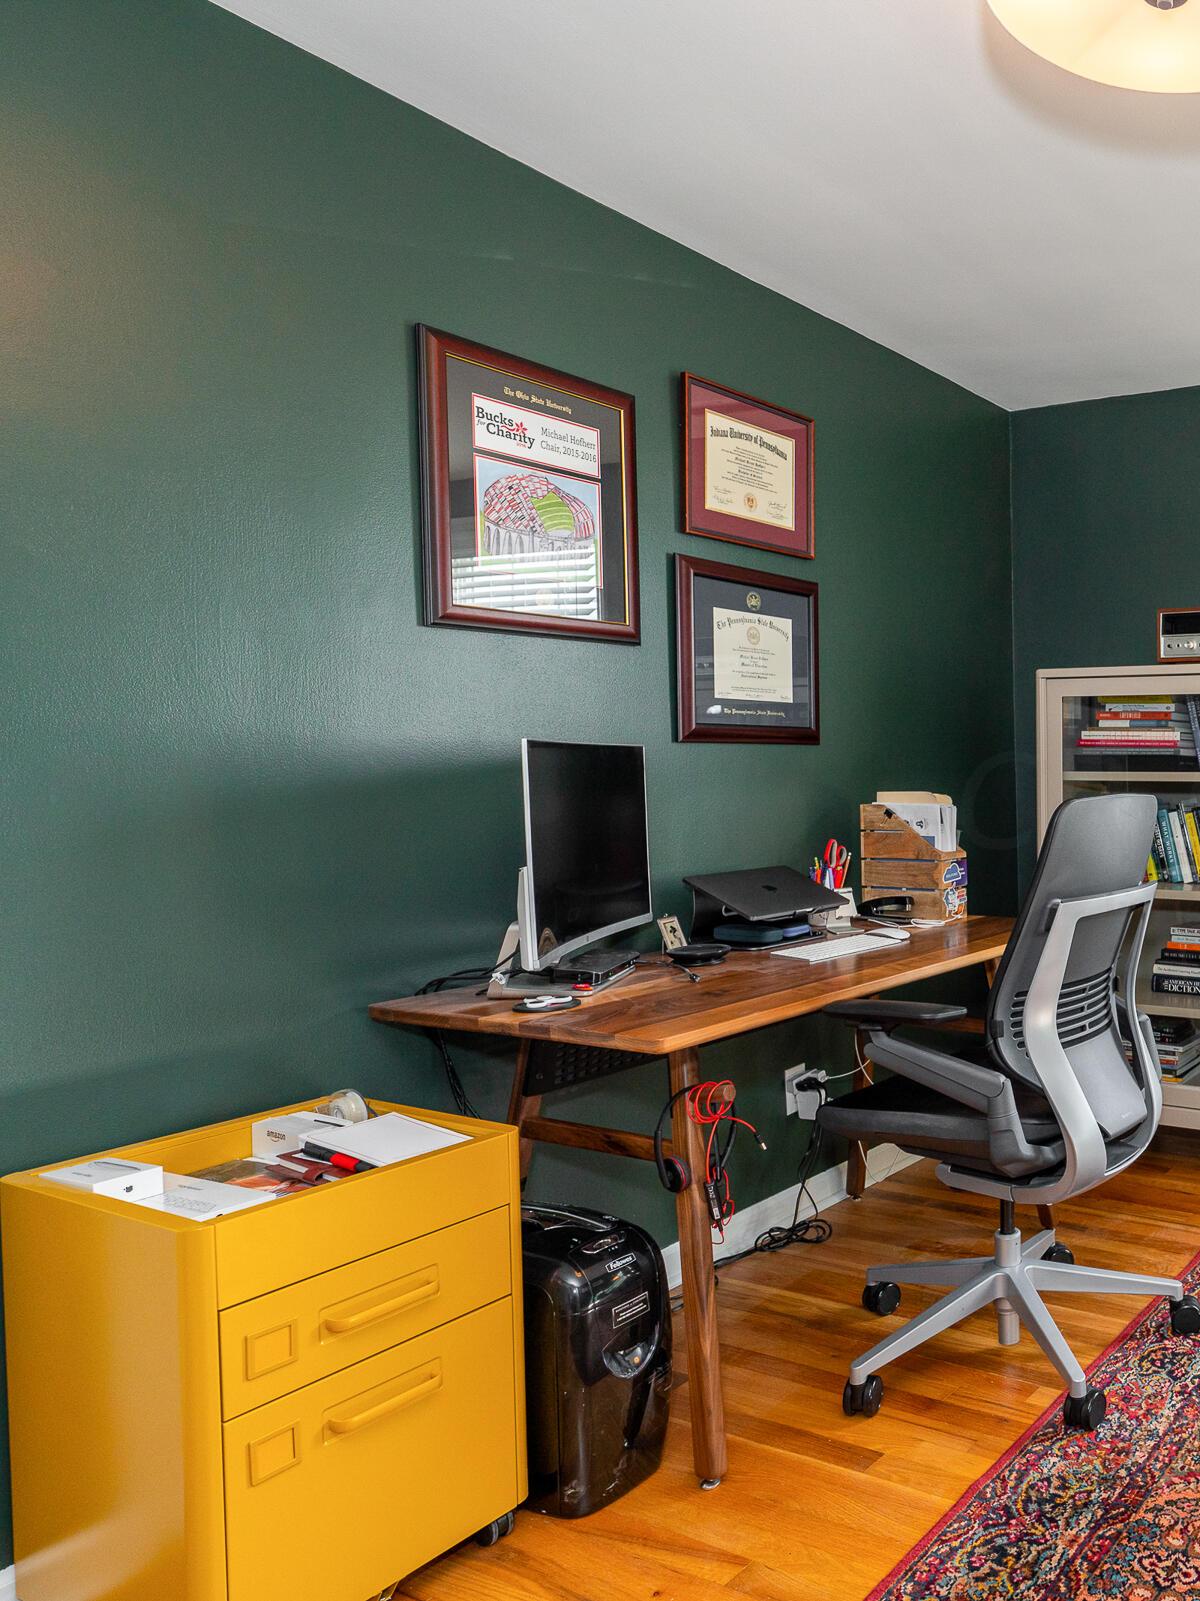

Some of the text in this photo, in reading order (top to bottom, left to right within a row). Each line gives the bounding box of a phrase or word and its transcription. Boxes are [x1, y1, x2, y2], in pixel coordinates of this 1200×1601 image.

[504, 386, 514, 397] The
[530, 394, 545, 406] State
[475, 406, 514, 427] Bucks
[486, 422, 536, 449] Charity
[541, 426, 596, 450] Michael Hofherr
[753, 434, 759, 444] of
[540, 440, 597, 463] Chair, 2015-2016
[1166, 840, 1174, 863] WORKS
[266, 1130, 286, 1142] amazon
[610, 1256, 633, 1270] Fellowes
